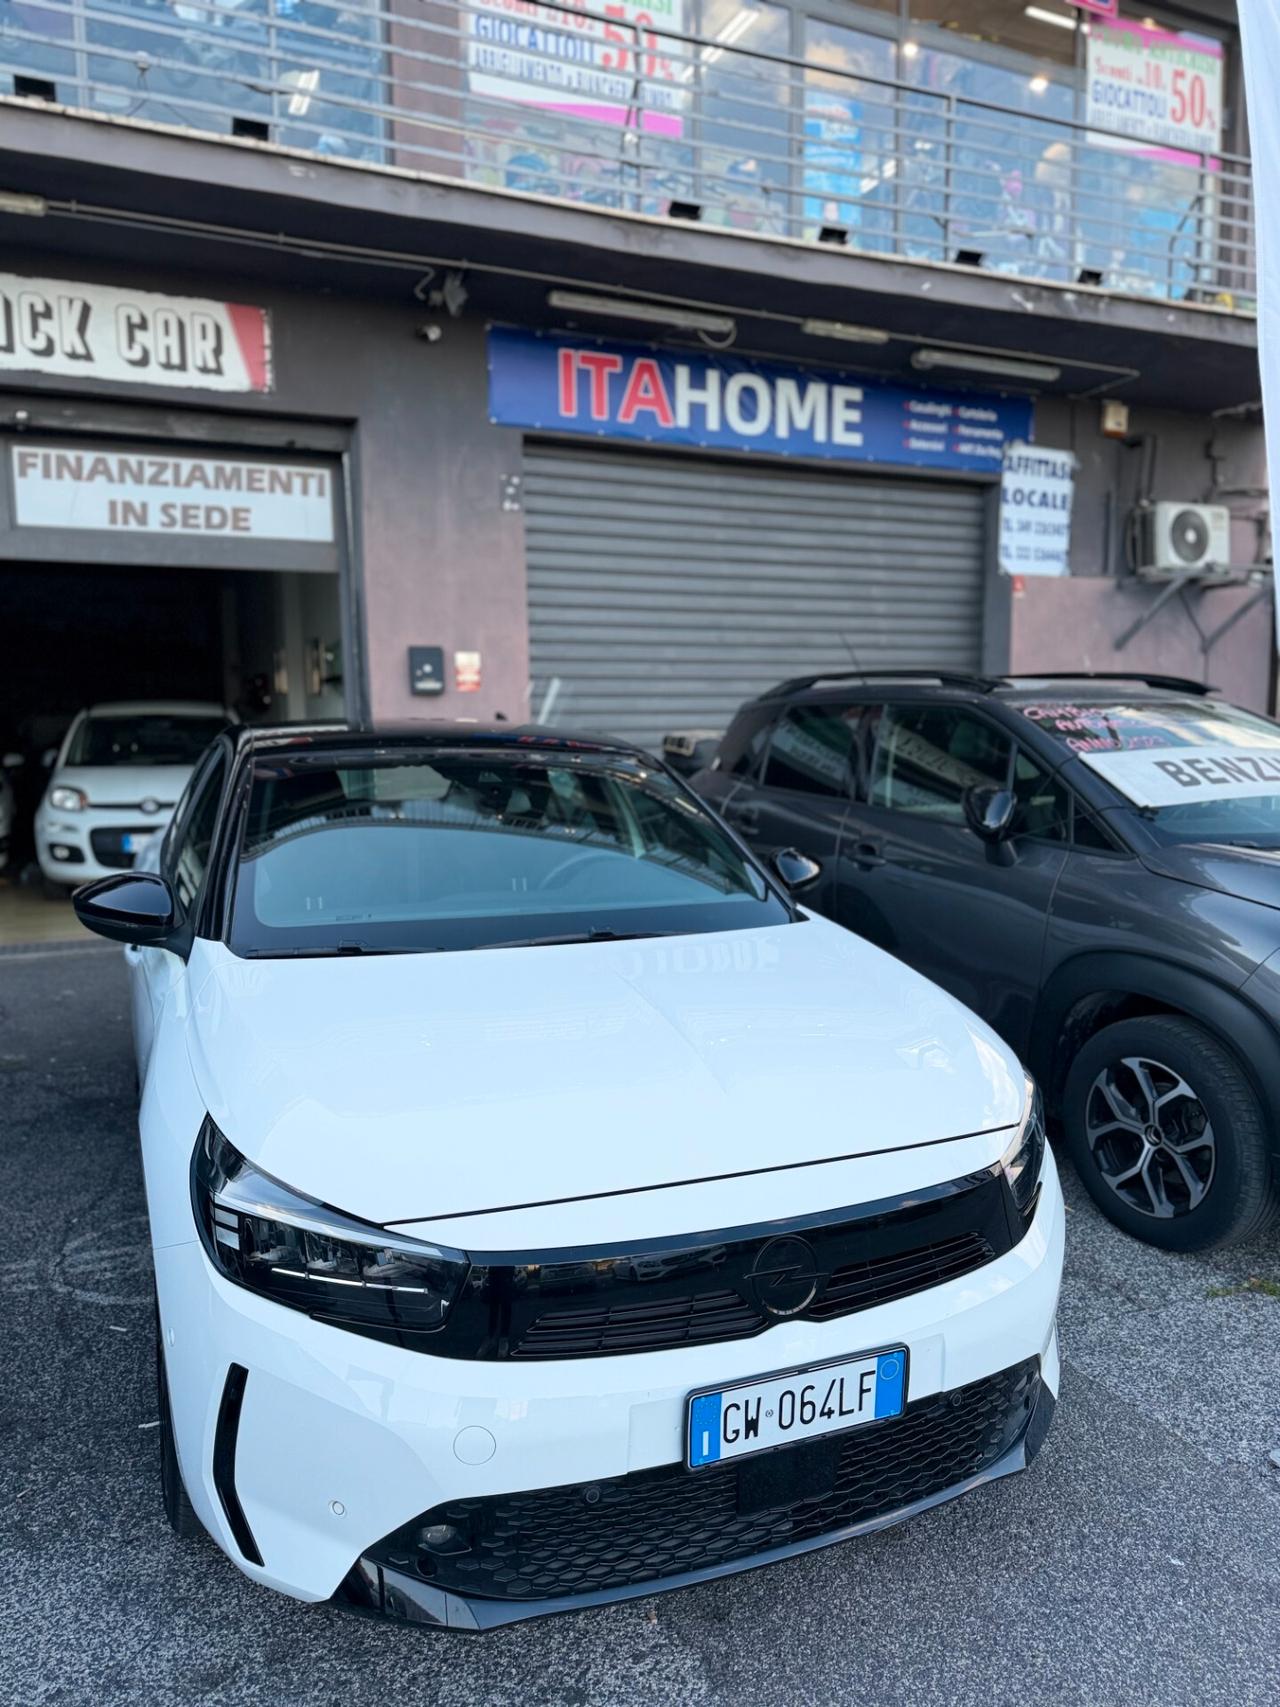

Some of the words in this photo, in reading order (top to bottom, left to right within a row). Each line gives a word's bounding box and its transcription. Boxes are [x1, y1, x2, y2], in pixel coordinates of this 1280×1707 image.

[115, 302, 224, 376] CAR
[557, 347, 864, 448] ITAHOME
[16, 451, 327, 498] FINANZIAMENTI
[1001, 486, 1069, 511] LOCALE
[107, 499, 149, 527] IN
[159, 503, 253, 532] SEDE
[722, 1396, 762, 1444] GW
[777, 1369, 877, 1430] 064LF
